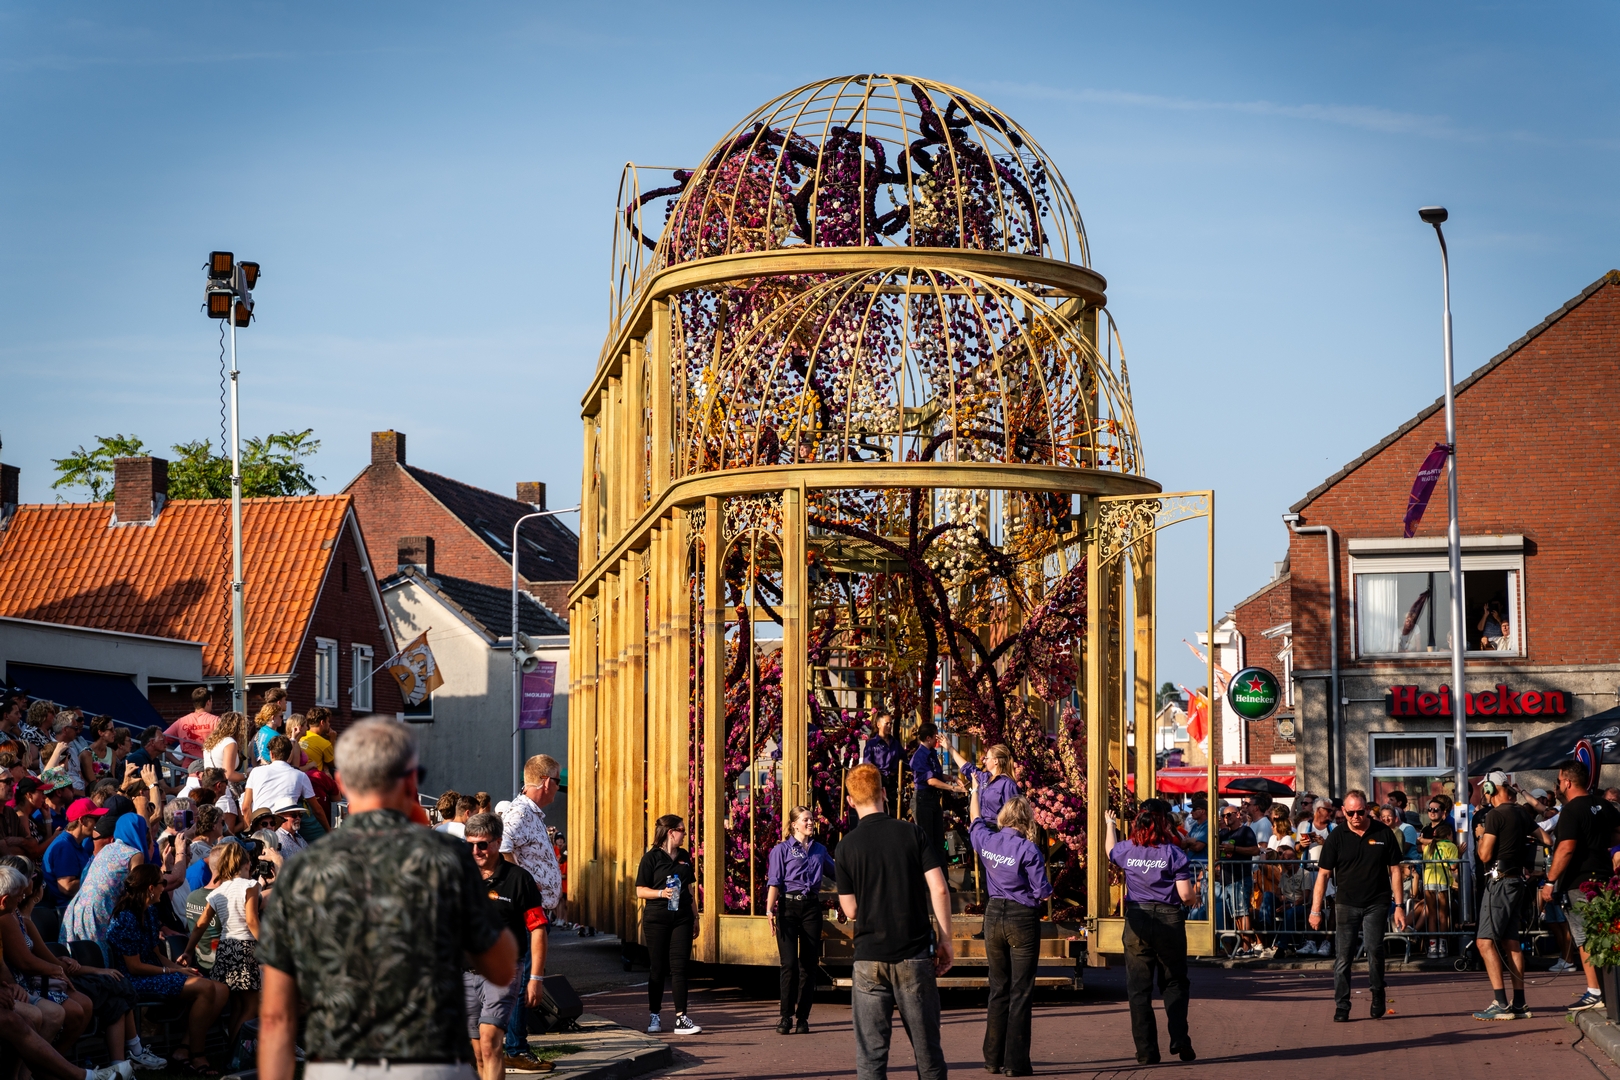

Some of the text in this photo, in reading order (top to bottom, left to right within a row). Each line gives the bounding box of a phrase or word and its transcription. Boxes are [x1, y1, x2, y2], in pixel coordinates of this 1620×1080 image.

[1235, 694, 1275, 704] Heineken
[182, 723, 210, 731] Cabana
[981, 848, 1016, 869] orangerie
[1126, 857, 1168, 875] orangerie
